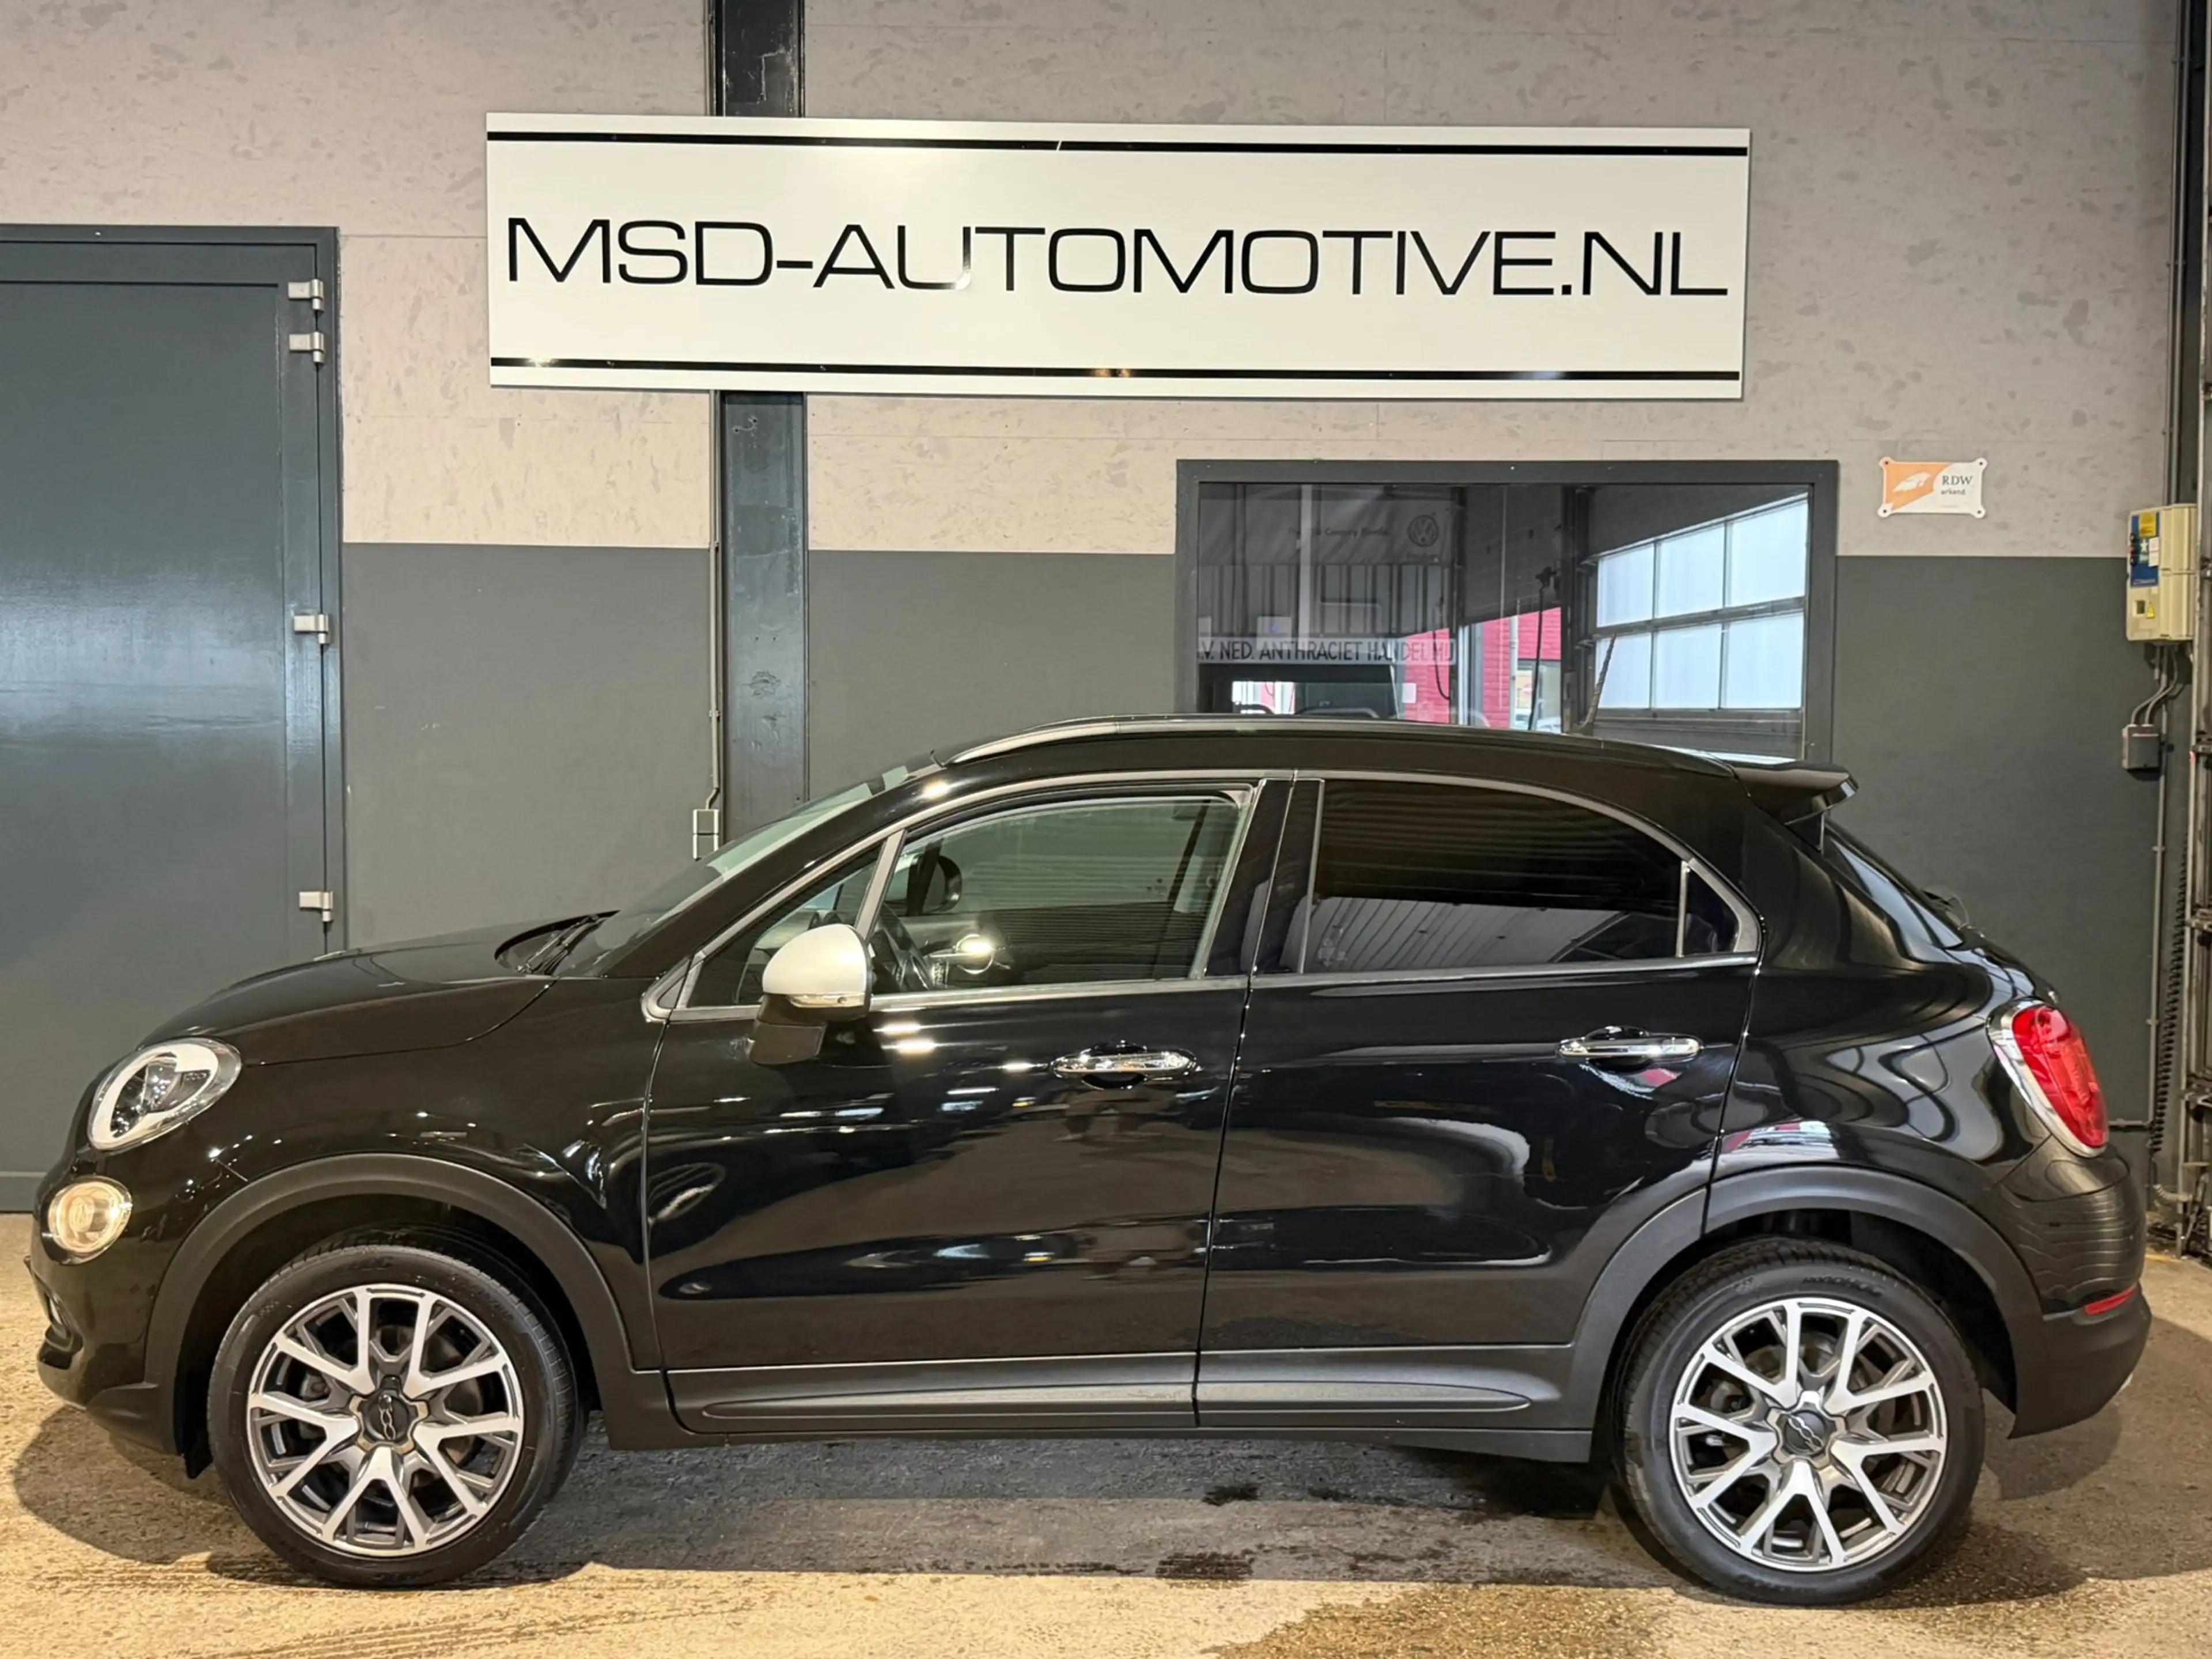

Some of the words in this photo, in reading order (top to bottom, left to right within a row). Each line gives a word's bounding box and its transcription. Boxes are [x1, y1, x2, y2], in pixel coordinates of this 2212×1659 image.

[508, 217, 1729, 296] MSD-AUTOMOTIVE.NL
[1942, 475, 1974, 486] RDW
[1219, 640, 1254, 660] NED.
[1259, 640, 1363, 661] ANTHRACIET
